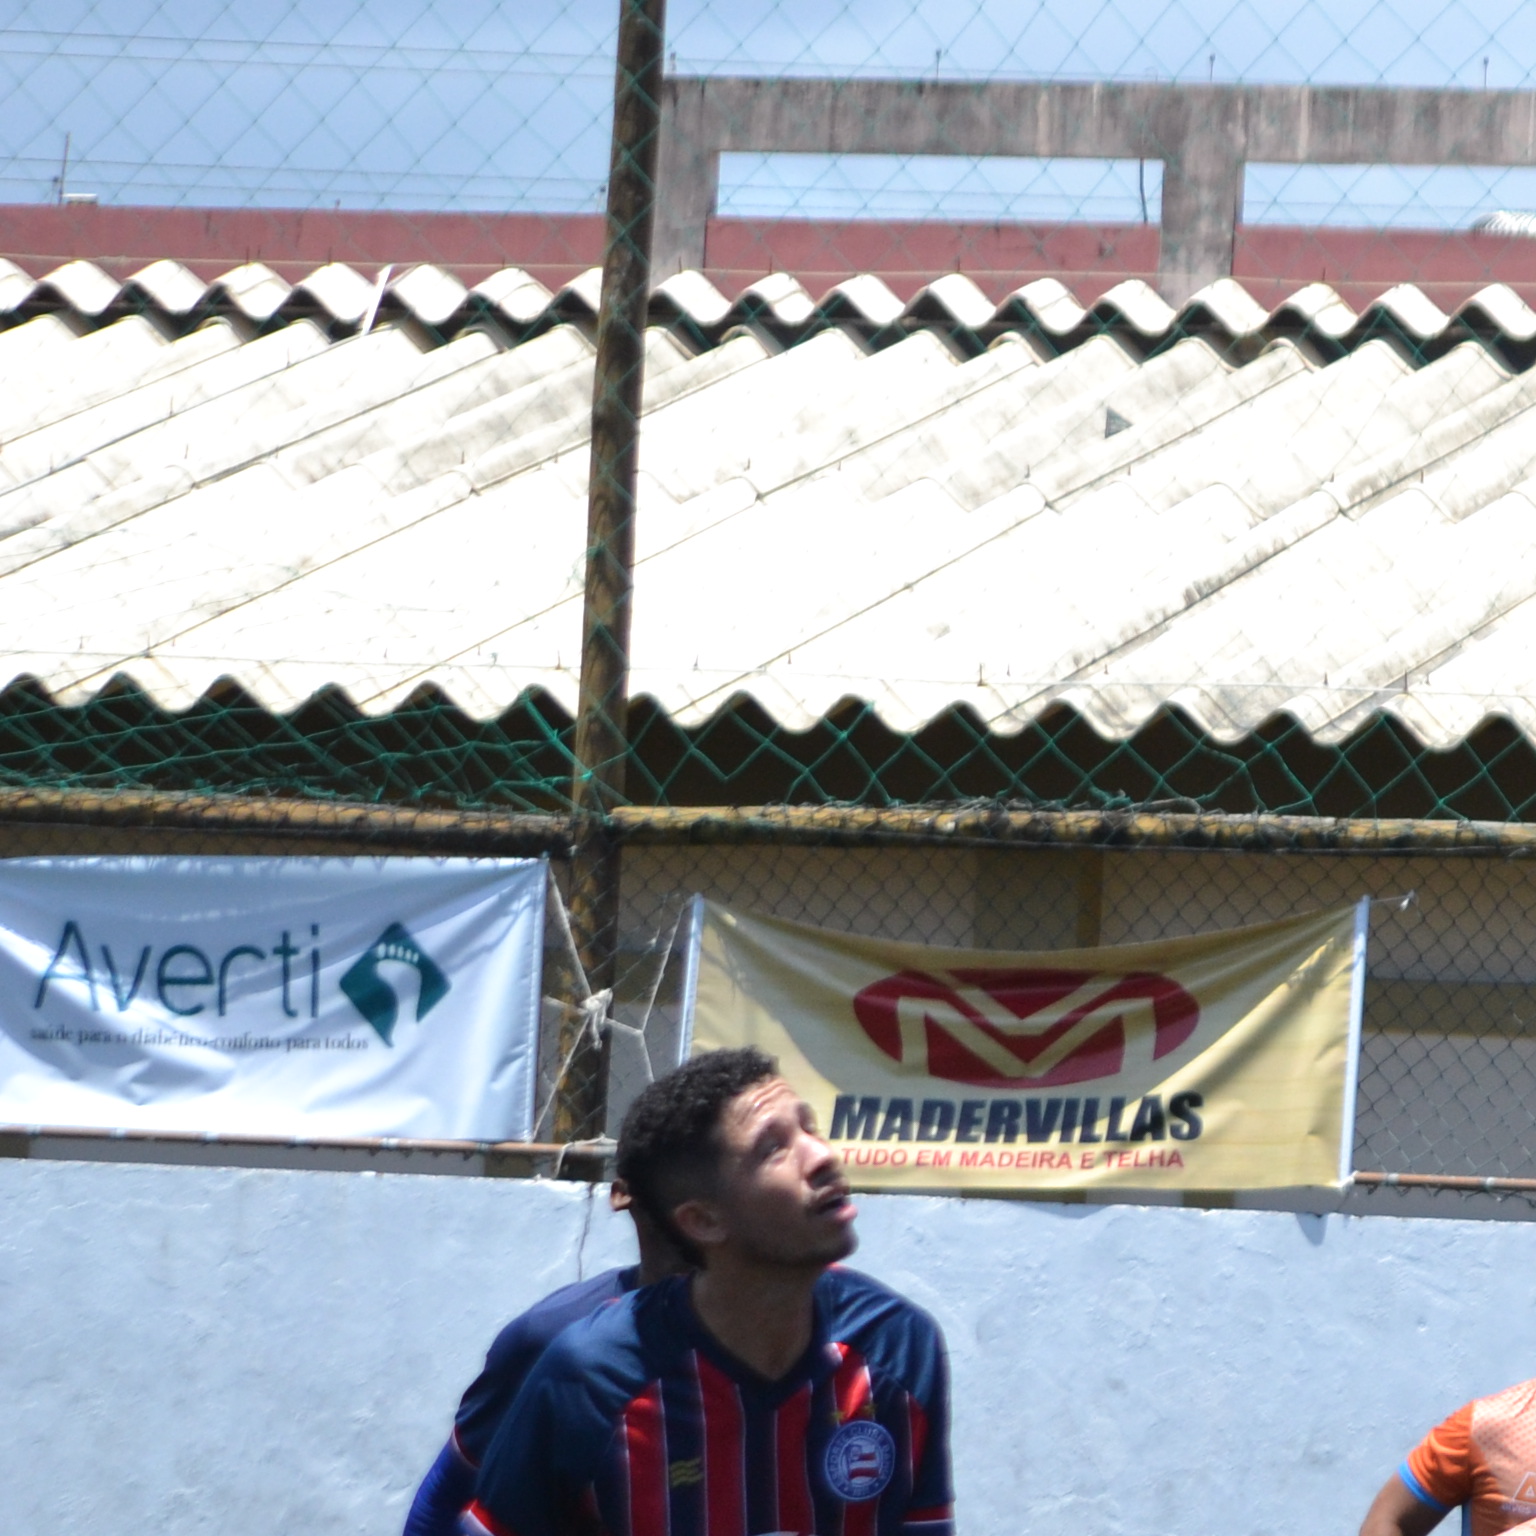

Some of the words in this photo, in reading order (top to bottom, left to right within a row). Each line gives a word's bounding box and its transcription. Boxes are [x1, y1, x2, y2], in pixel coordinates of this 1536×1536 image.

[34, 920, 321, 1019] Averti
[287, 1036, 320, 1052] para
[325, 1032, 369, 1050] todos
[829, 1090, 1204, 1143] MADERVILLAS
[841, 1146, 908, 1168] TUDO
[916, 1148, 951, 1168] EM
[959, 1149, 1073, 1170] MADEIRA
[1080, 1151, 1096, 1170] E
[1103, 1149, 1185, 1169] TELHA
